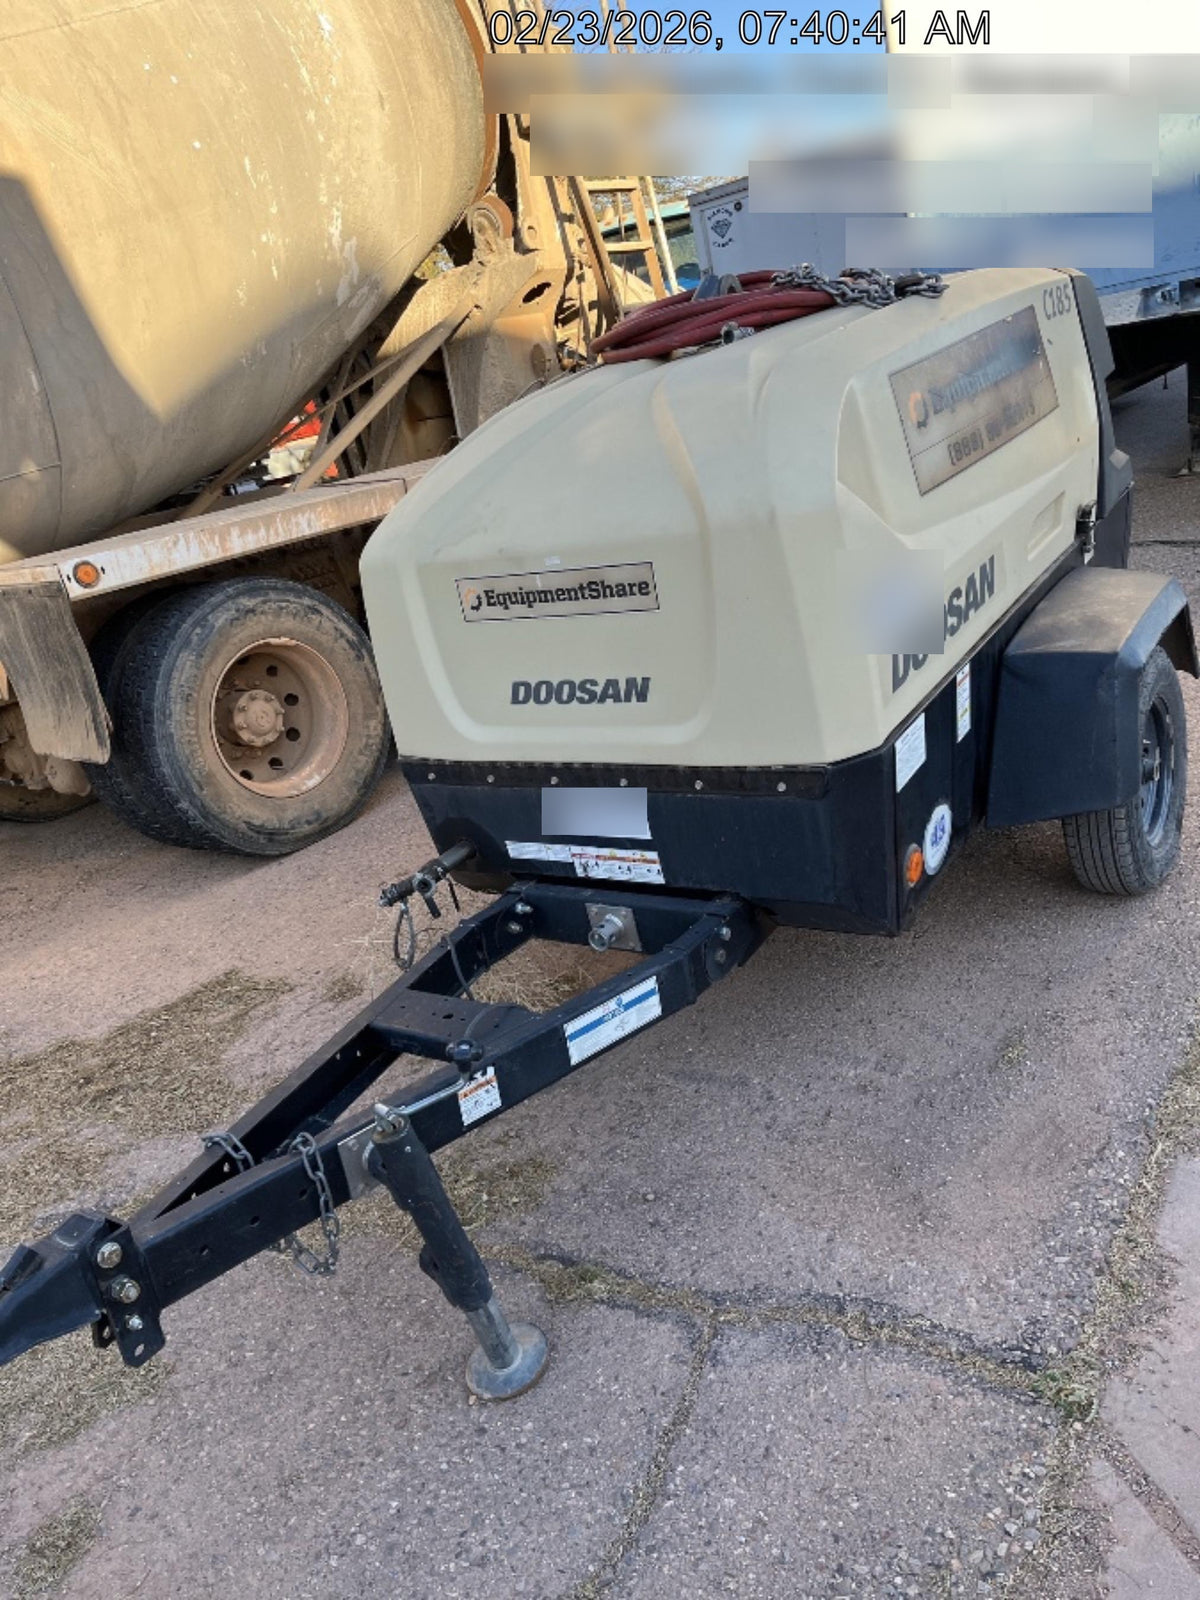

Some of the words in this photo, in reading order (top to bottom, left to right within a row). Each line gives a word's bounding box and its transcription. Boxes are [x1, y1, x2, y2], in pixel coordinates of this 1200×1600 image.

[1043, 283, 1071, 321] C185
[483, 578, 651, 611] EquipmentShare
[510, 677, 651, 706] DOOSAN
